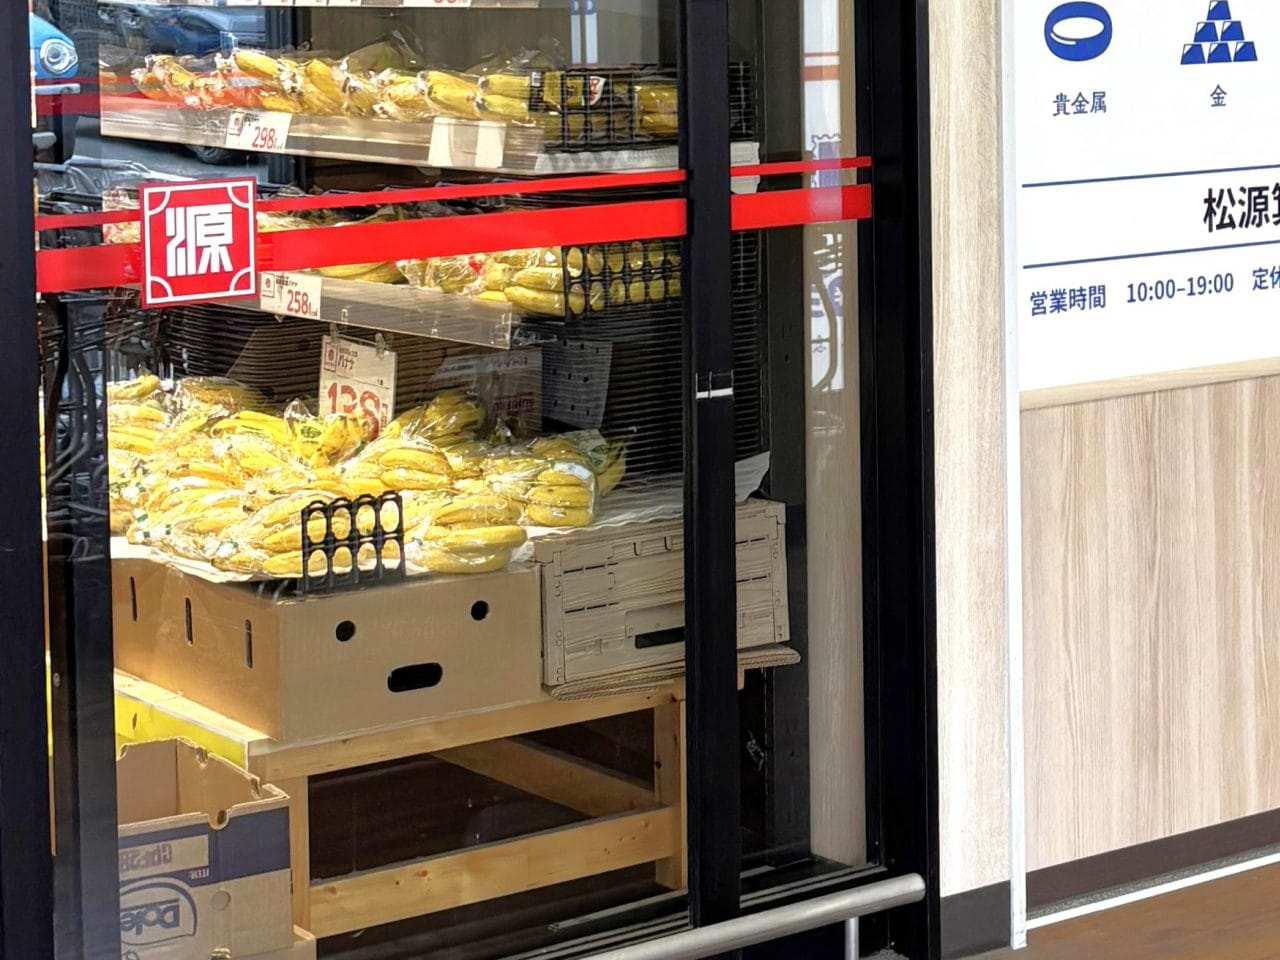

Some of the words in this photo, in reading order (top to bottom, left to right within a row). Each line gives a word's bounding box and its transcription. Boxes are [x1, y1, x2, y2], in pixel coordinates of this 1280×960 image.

[1052, 91, 1107, 116] 貴金属
[1210, 84, 1228, 107] 金
[252, 126, 275, 150] 298
[165, 204, 233, 277] 源
[287, 289, 309, 315] 258
[1029, 285, 1107, 316] 営業時間
[1126, 272, 1234, 303] 10:00-19:00
